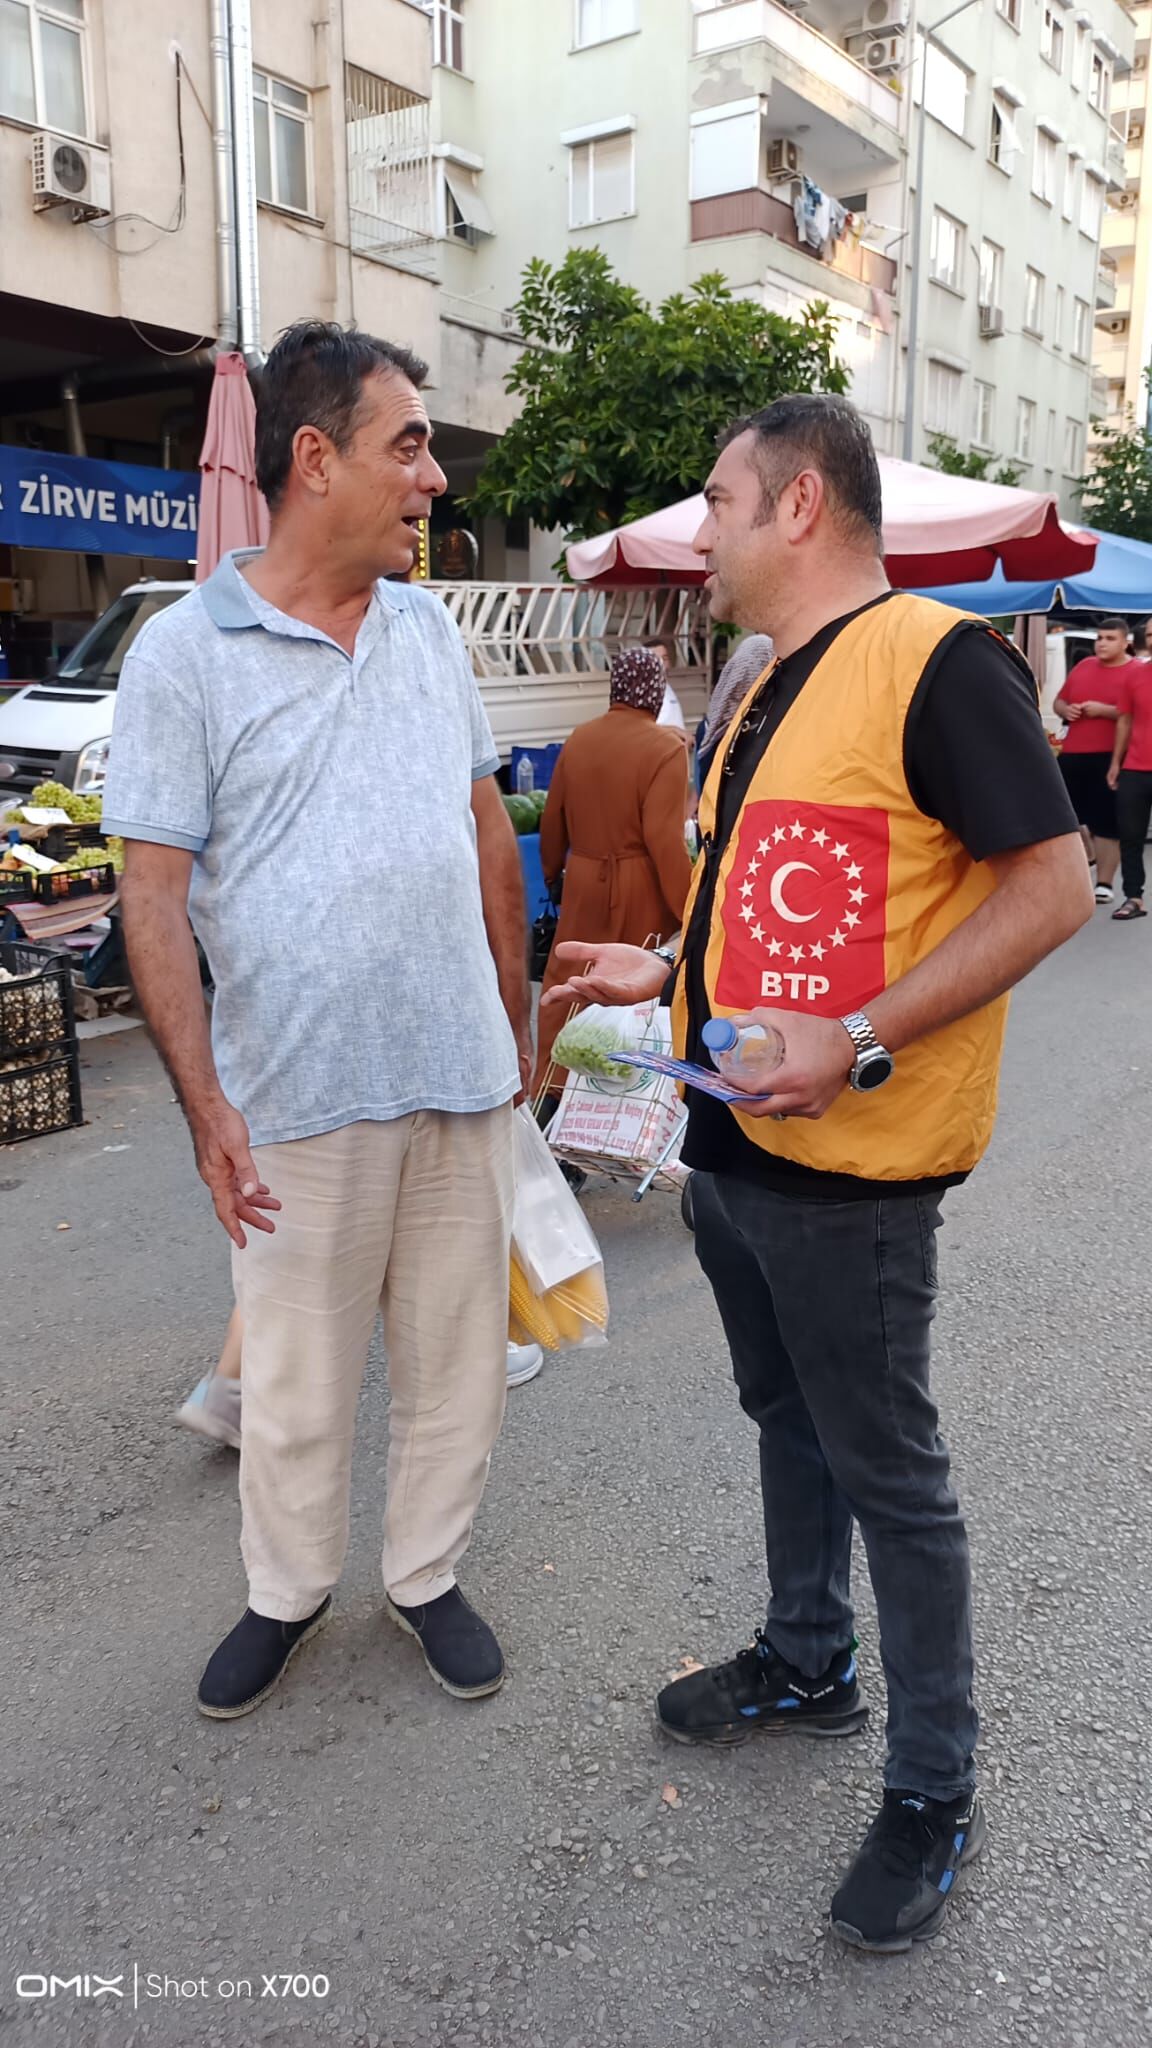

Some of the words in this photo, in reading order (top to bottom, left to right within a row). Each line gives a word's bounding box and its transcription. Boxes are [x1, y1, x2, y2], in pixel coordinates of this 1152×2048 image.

[19, 474, 118, 522] ZİRVE
[125, 490, 199, 531] MÜZİ
[761, 970, 830, 1000] BTP
